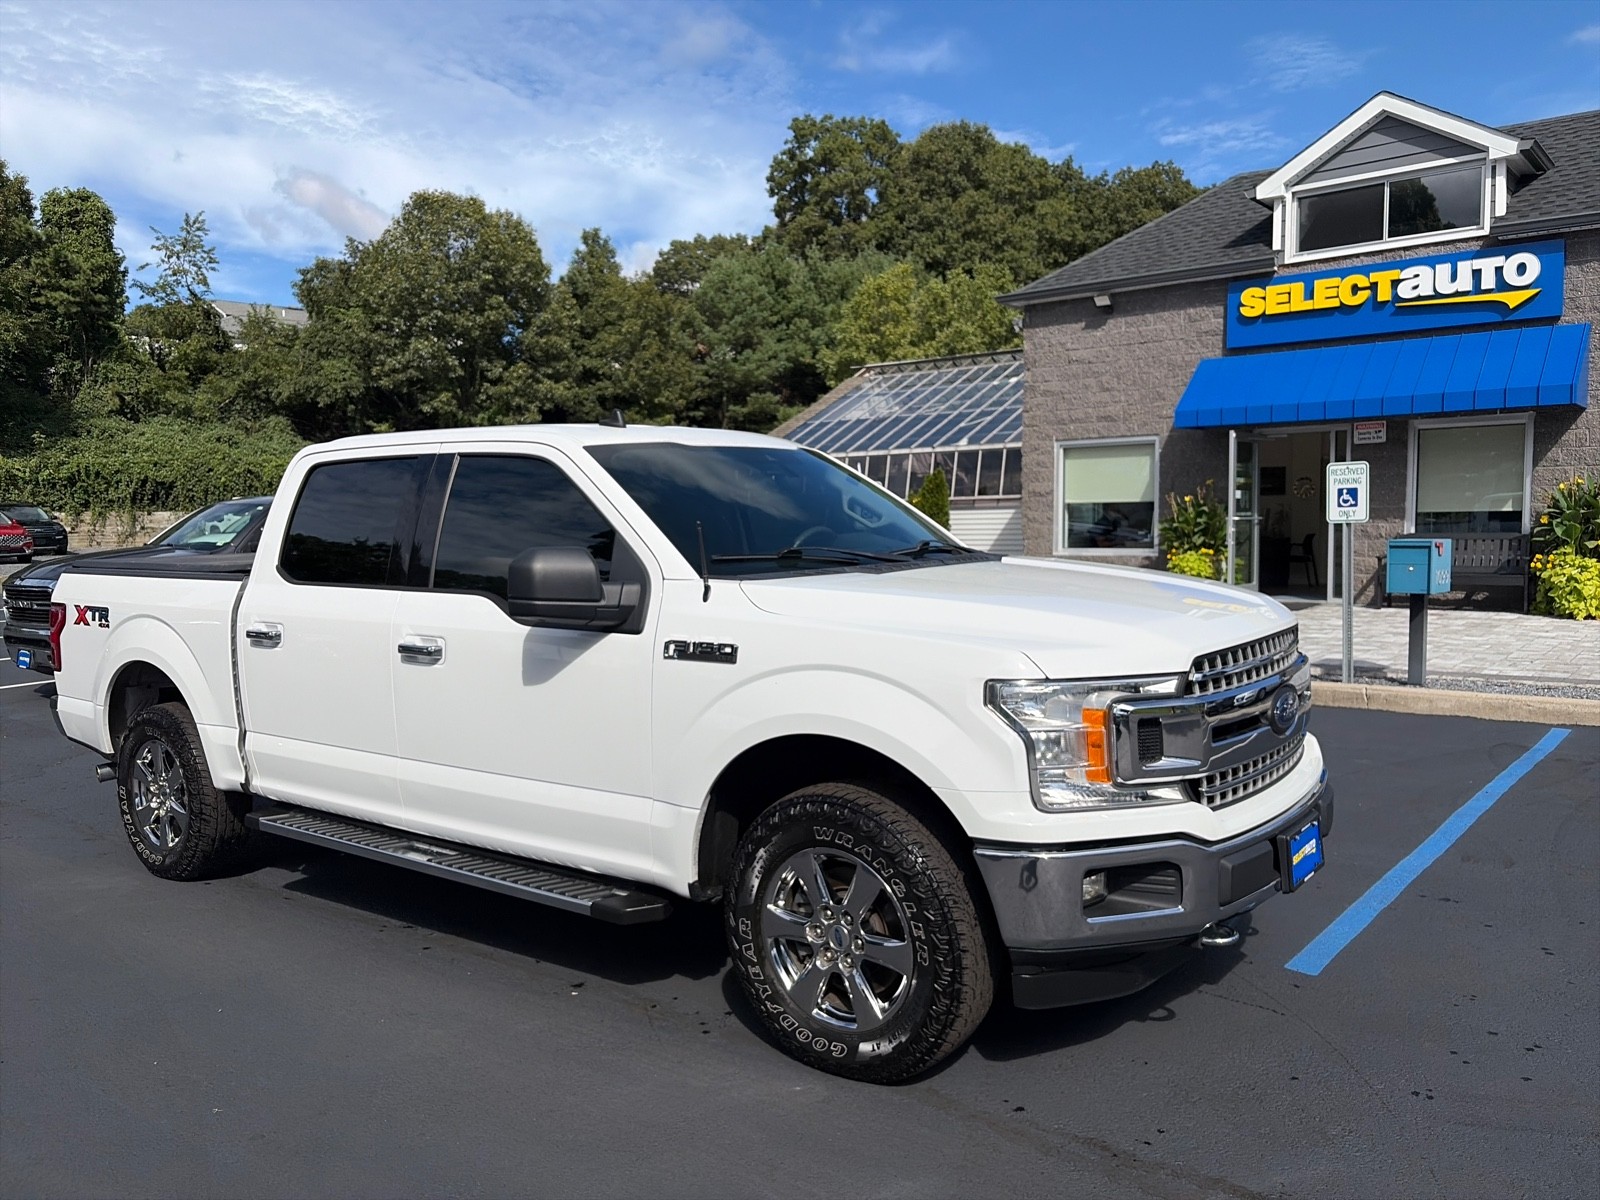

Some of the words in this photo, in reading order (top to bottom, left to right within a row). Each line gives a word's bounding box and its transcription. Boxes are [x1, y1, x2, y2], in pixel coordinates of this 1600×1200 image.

[1331, 467, 1365, 477] RESERVED
[1333, 477, 1362, 486] PARKING
[1338, 509, 1356, 517] ONLY
[73, 604, 110, 626] XTR
[813, 825, 929, 967] WRANGLER
[738, 916, 848, 1057] GOODYEAR
